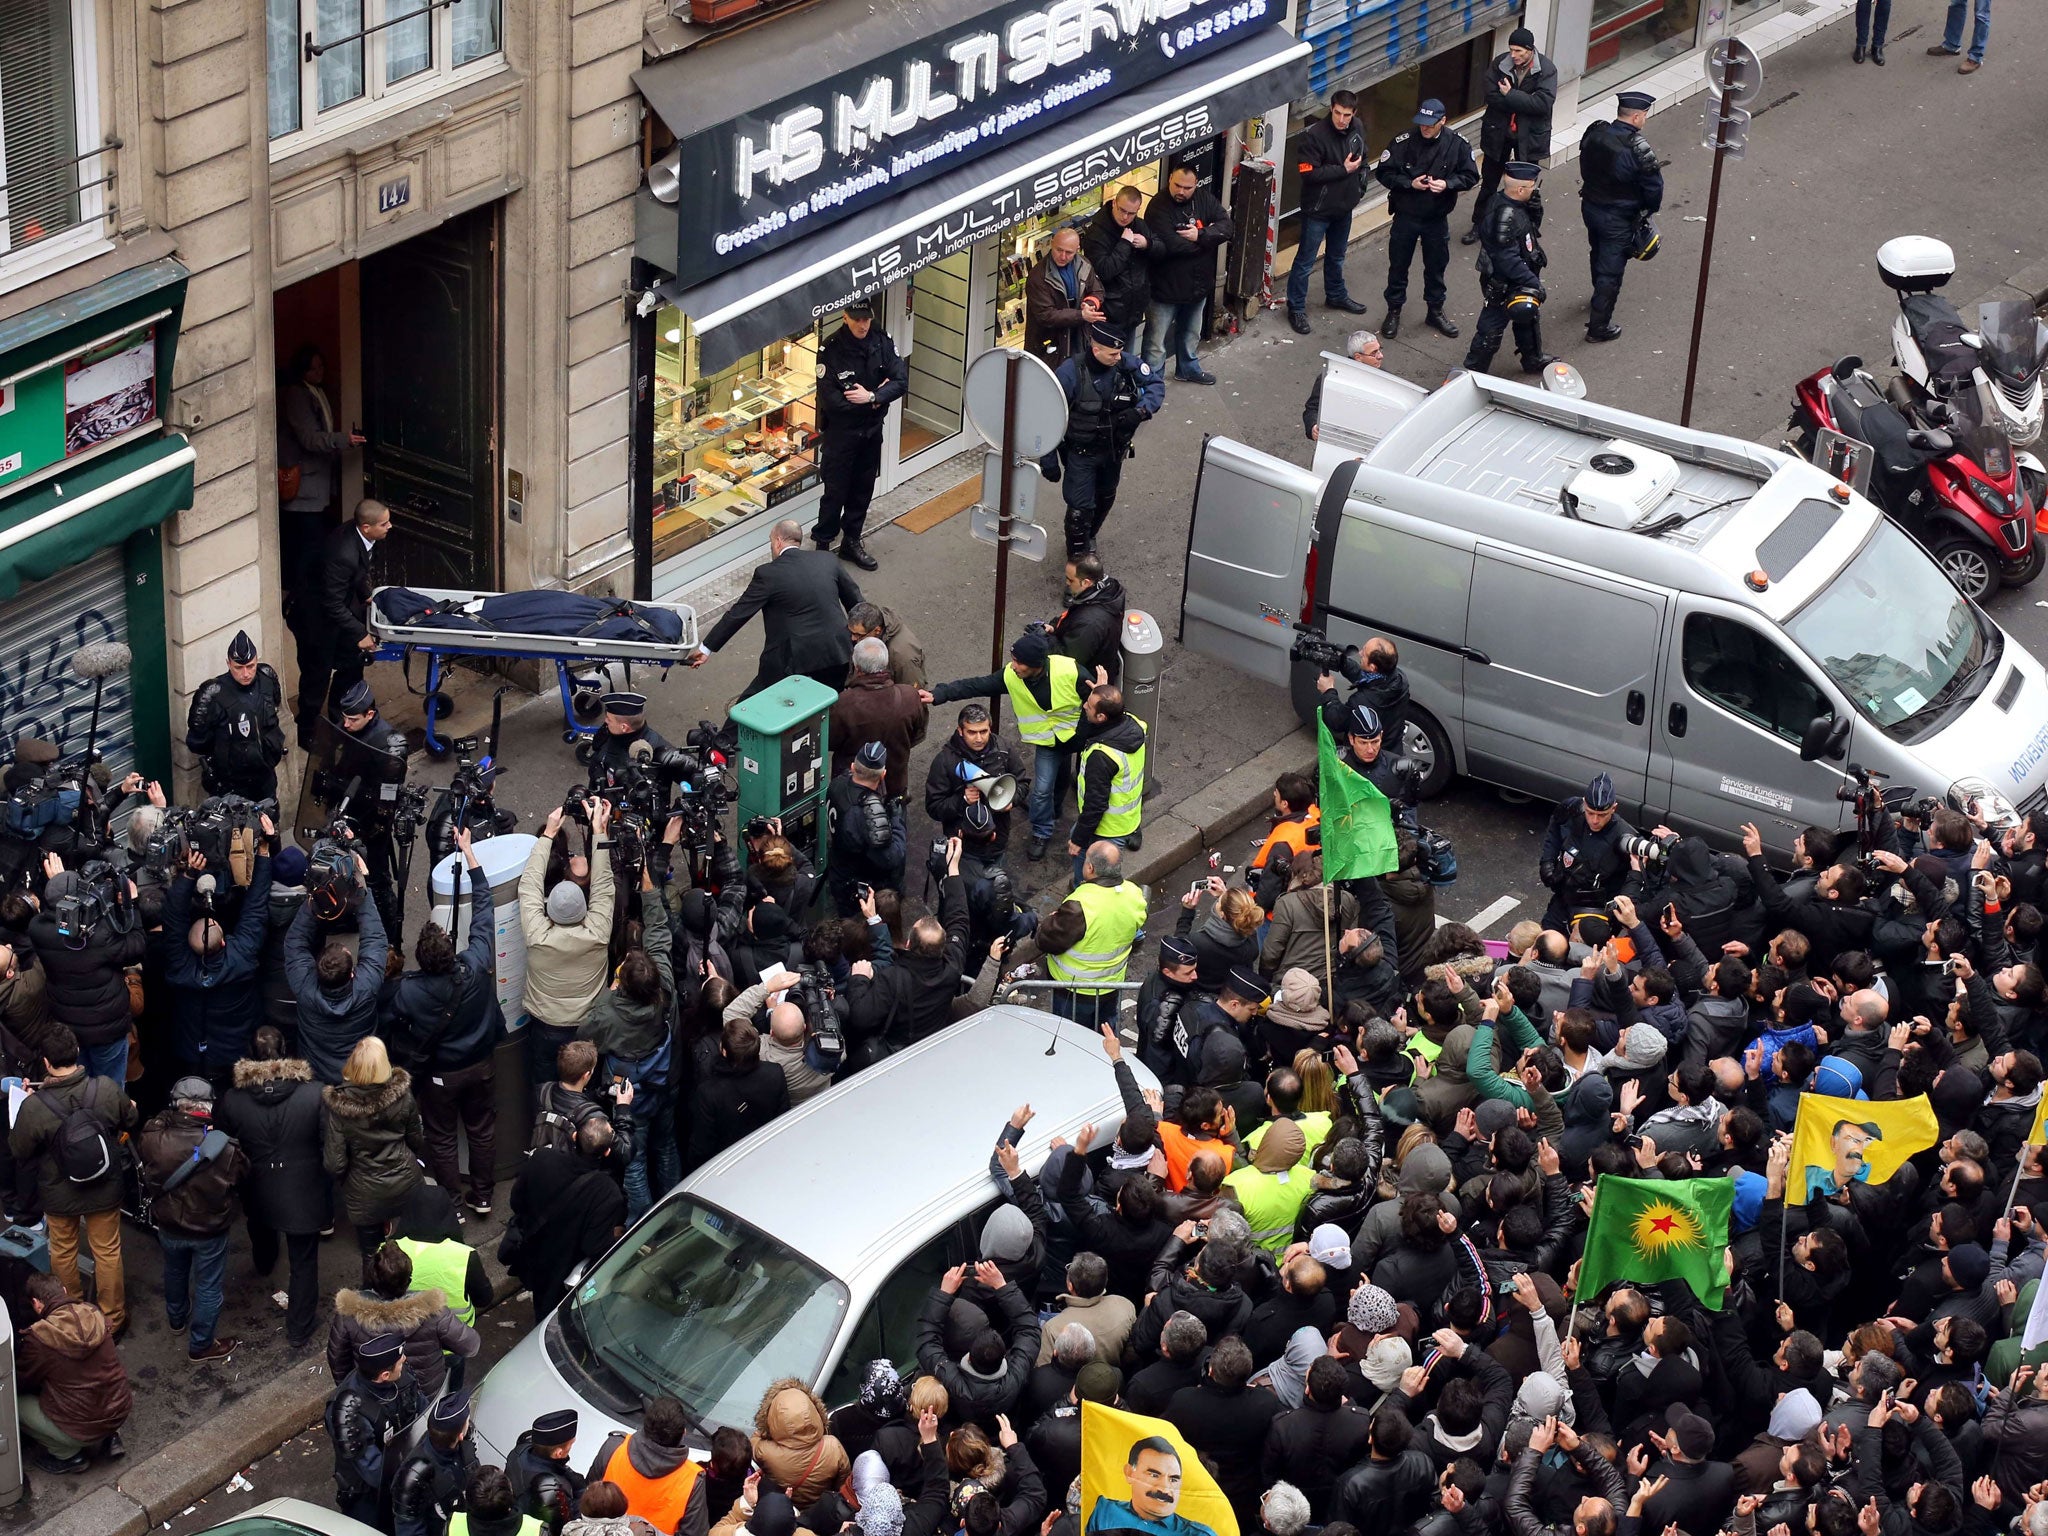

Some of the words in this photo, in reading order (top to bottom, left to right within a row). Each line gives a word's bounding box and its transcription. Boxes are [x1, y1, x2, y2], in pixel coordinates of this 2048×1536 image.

[1176, 27, 1195, 50] 09
[1194, 18, 1213, 42] 52
[1213, 10, 1232, 33] 56
[1230, 2, 1250, 26] 94
[1248, 0, 1268, 19] 26
[381, 177, 408, 212] 147
[714, 211, 787, 255] Grossiste
[788, 200, 809, 223] en
[889, 128, 980, 178] informatique
[978, 113, 997, 138] et
[996, 99, 1043, 136] pièces
[1041, 68, 1113, 110] détachées
[733, 105, 824, 200] HS
[833, 30, 999, 157] MULTI
[851, 243, 903, 288] HS
[916, 187, 1022, 256] MULTI
[1033, 104, 1211, 202] SERVICES
[811, 290, 862, 318] Grossiste
[864, 280, 880, 295] en
[882, 248, 942, 284] téléphonie,
[944, 216, 1011, 255] informatique
[1013, 207, 1027, 222] et
[1026, 193, 1063, 218] pièces
[1136, 149, 1152, 163] 09
[1153, 142, 1166, 157] 52
[1168, 135, 1183, 151] 56
[1184, 129, 1197, 143] 94
[1200, 122, 1214, 138] 26
[1720, 775, 1754, 793] Services
[1754, 785, 1794, 805] Funéraires
